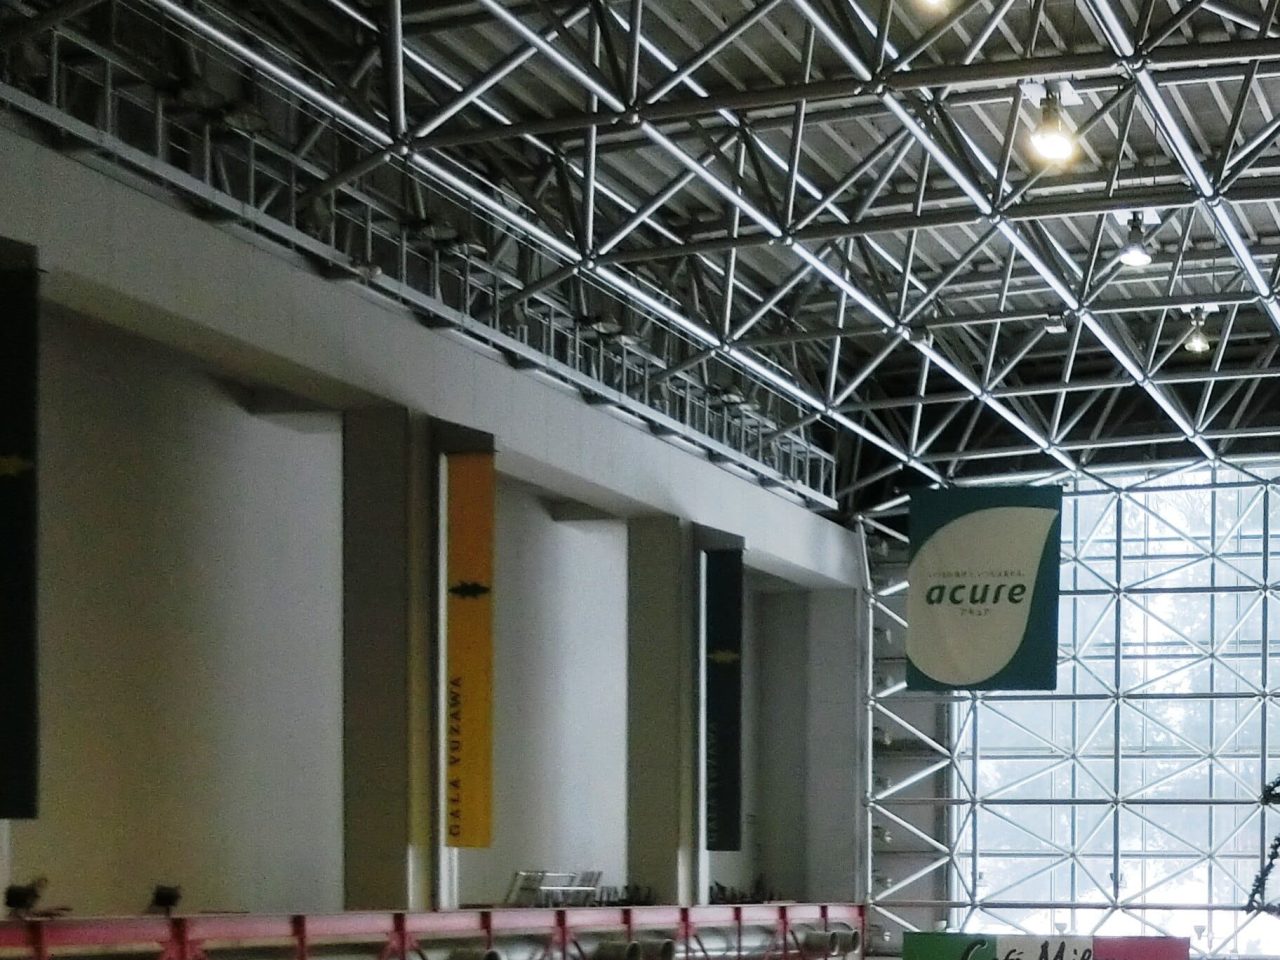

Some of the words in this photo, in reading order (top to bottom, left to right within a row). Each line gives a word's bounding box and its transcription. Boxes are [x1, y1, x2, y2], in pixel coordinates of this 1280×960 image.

[926, 583, 1026, 605] acure
[448, 676, 461, 766] YUZAWA
[449, 778, 461, 838] GALA
